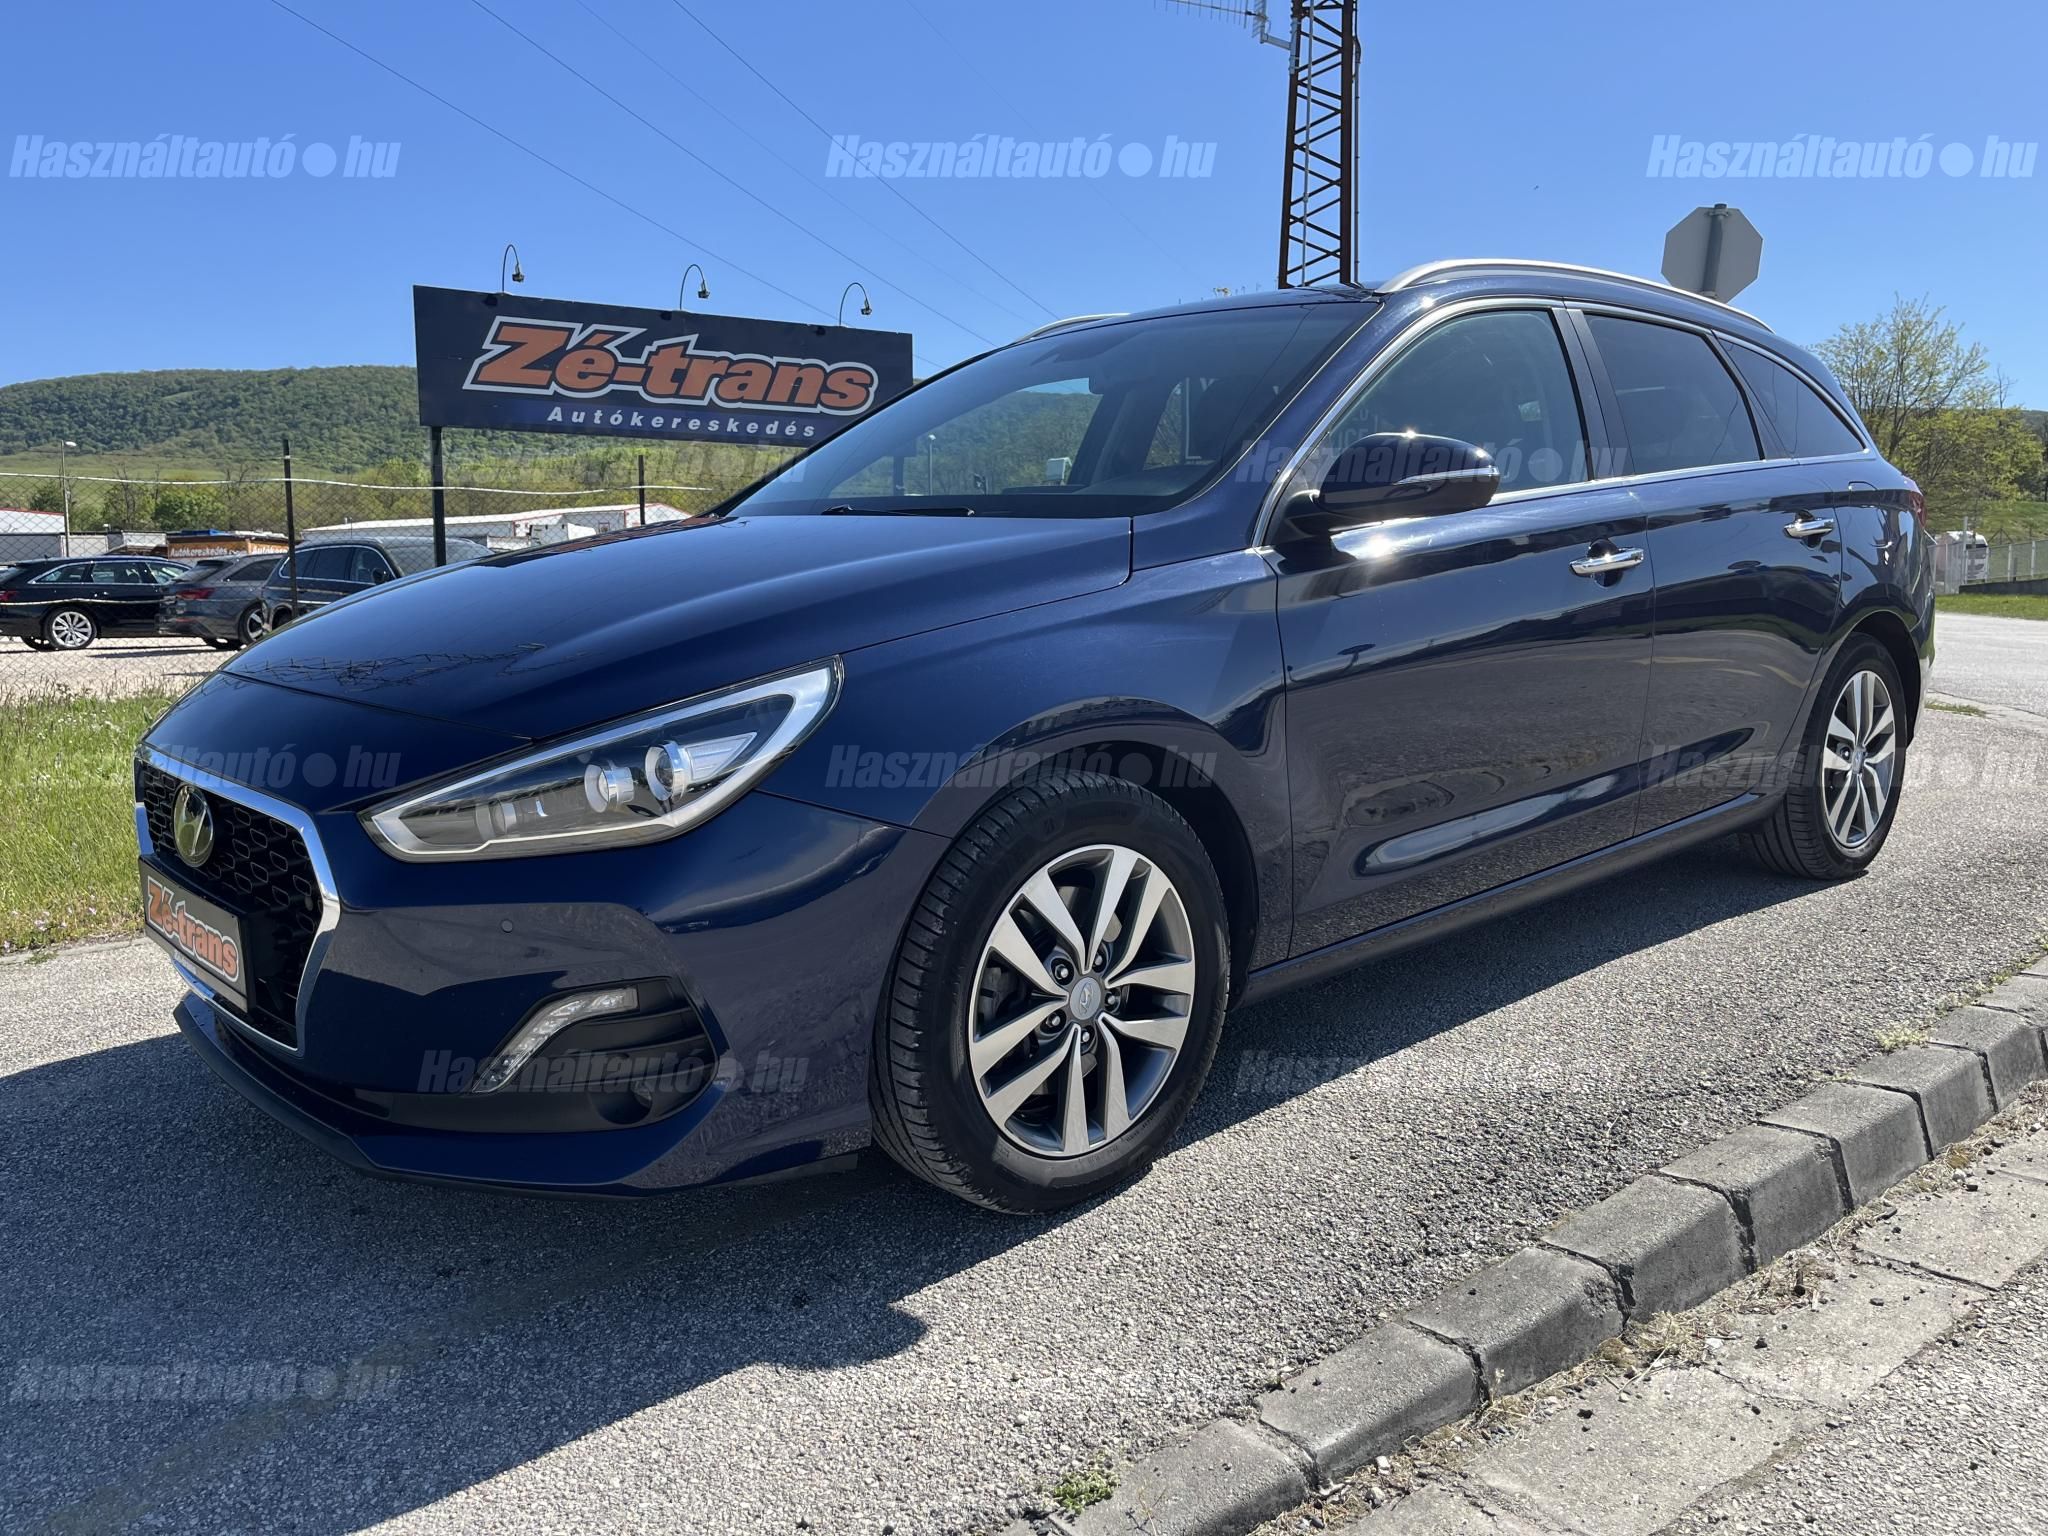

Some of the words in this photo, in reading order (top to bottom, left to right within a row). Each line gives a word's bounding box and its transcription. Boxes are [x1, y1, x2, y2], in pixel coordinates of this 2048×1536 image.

[467, 320, 876, 412] Zé-trans
[547, 405, 817, 438] Autókereskedés
[148, 877, 239, 982] Zé-trans
